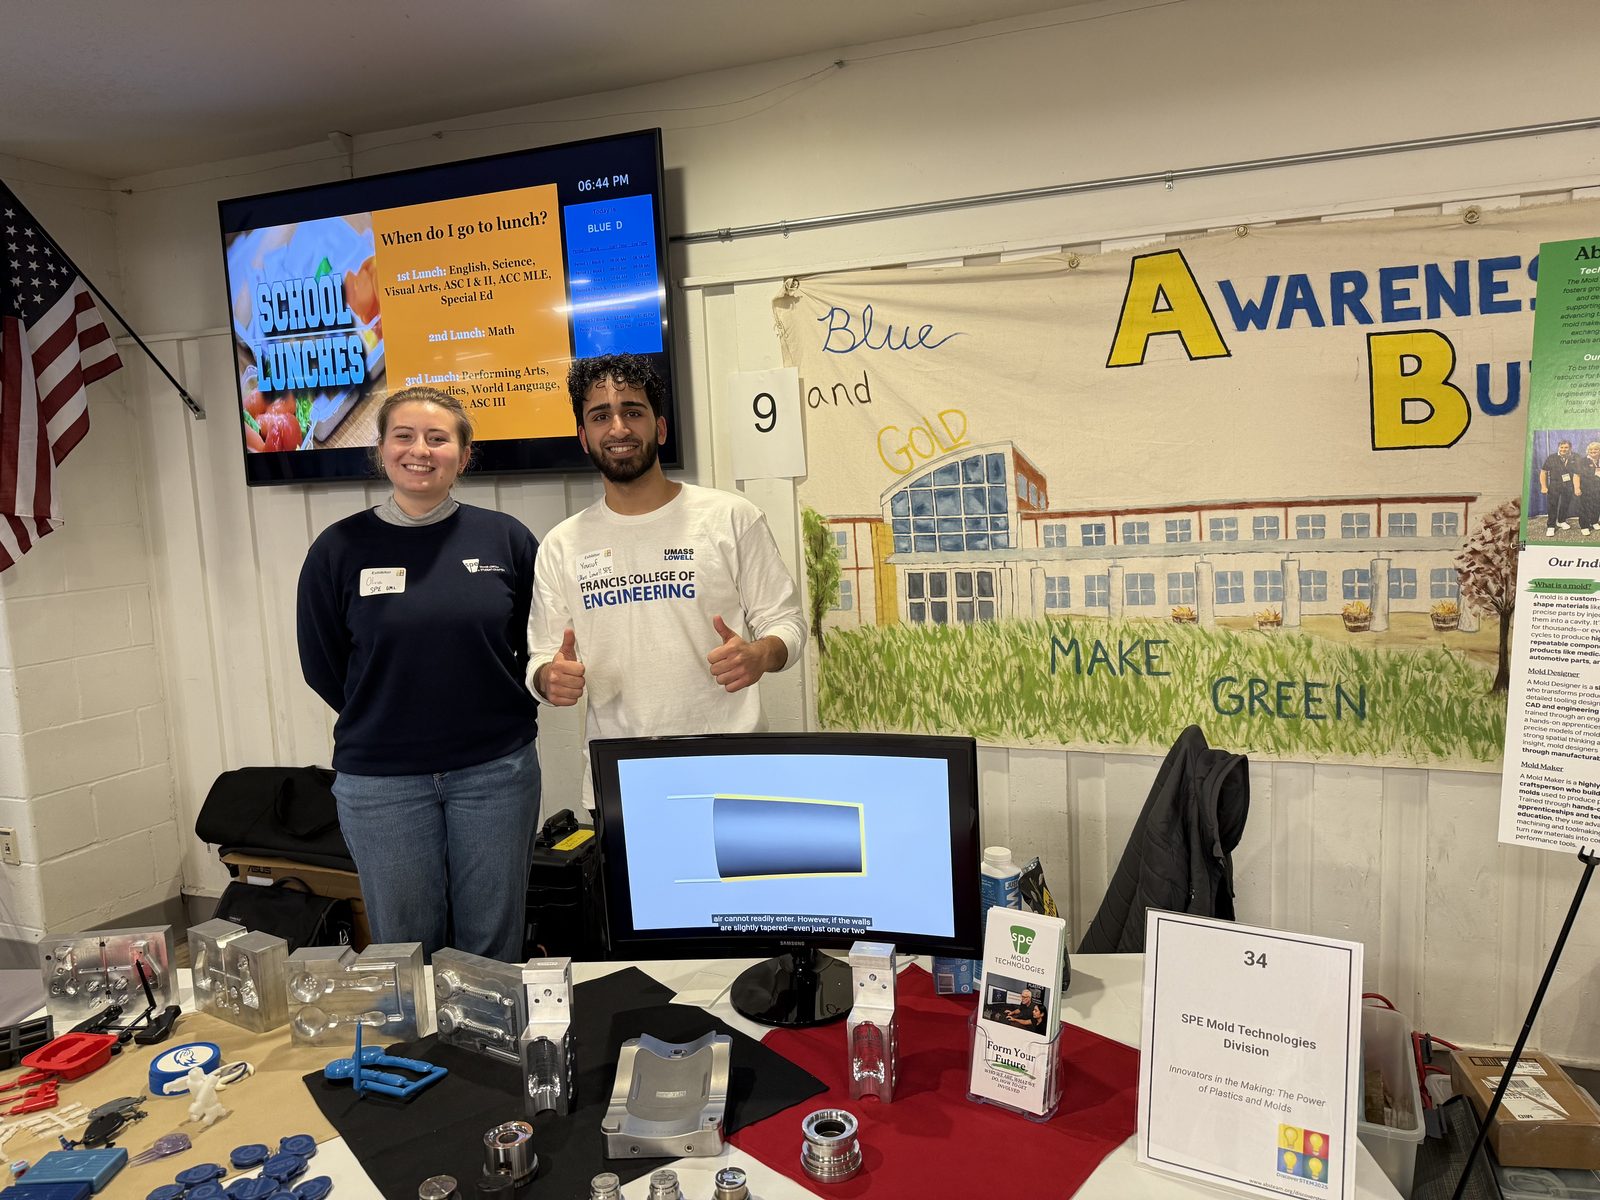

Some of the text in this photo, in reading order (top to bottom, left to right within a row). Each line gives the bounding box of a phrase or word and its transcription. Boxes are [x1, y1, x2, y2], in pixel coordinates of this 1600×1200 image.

[578, 174, 629, 191] 06:44 PM
[381, 211, 548, 246] When do I go to lunch?
[588, 221, 622, 233] BLUE D
[397, 257, 535, 282] 1st Lunch: English, Science,
[385, 270, 551, 296] Visual Arts, ASC I & II, ACC MLE,
[257, 273, 352, 334] SCHOOL
[441, 290, 493, 306] Special Ed
[1106, 248, 1540, 368] AWARENE
[429, 325, 515, 342] 2nd Lunch: Math
[817, 304, 969, 353] Blue
[254, 335, 364, 391] LUNCHES
[406, 366, 549, 386] 3rd Lunch: Performing Arts,
[471, 383, 504, 394] World
[507, 380, 560, 392] Language,
[808, 370, 871, 408] and
[470, 399, 491, 408] ASC
[493, 398, 506, 406] III
[753, 393, 776, 432] 9
[877, 409, 970, 474] GOLD
[1549, 557, 1573, 567] Our
[580, 577, 626, 592] FRANCIS
[629, 571, 675, 584] COLLEGE
[679, 571, 694, 581] OF
[583, 584, 695, 610] ENGINEERING
[1051, 636, 1171, 676] MAKE
[1548, 669, 1580, 678] Designer
[1212, 676, 1367, 721] GREEN
[1557, 706, 1599, 714] engineering
[1521, 761, 1564, 772] Mold Maker
[1519, 781, 1564, 791] craftsperson
[1579, 780, 1600, 789] highly
[1567, 795, 1596, 803] produce
[1518, 804, 1574, 816] apprenticeships
[1518, 811, 1553, 820] education,
[1555, 816, 1570, 824] they
[1516, 834, 1577, 848] performance tools.
[751, 915, 774, 923] readily
[734, 924, 758, 932] slightly
[812, 925, 825, 933] just
[1011, 931, 1033, 954] spe
[995, 957, 1045, 975] TECHNOLOGIES
[1011, 954, 1030, 963] MOLD
[1243, 950, 1268, 968] 34
[1181, 1013, 1316, 1050] SPE Mold Technologies
[987, 1040, 1035, 1062] Form Your
[1223, 1038, 1269, 1057] Division
[1169, 1064, 1326, 1108] Innovators in the Making: The Power
[1198, 1084, 1292, 1113] of Plastics and Molds
